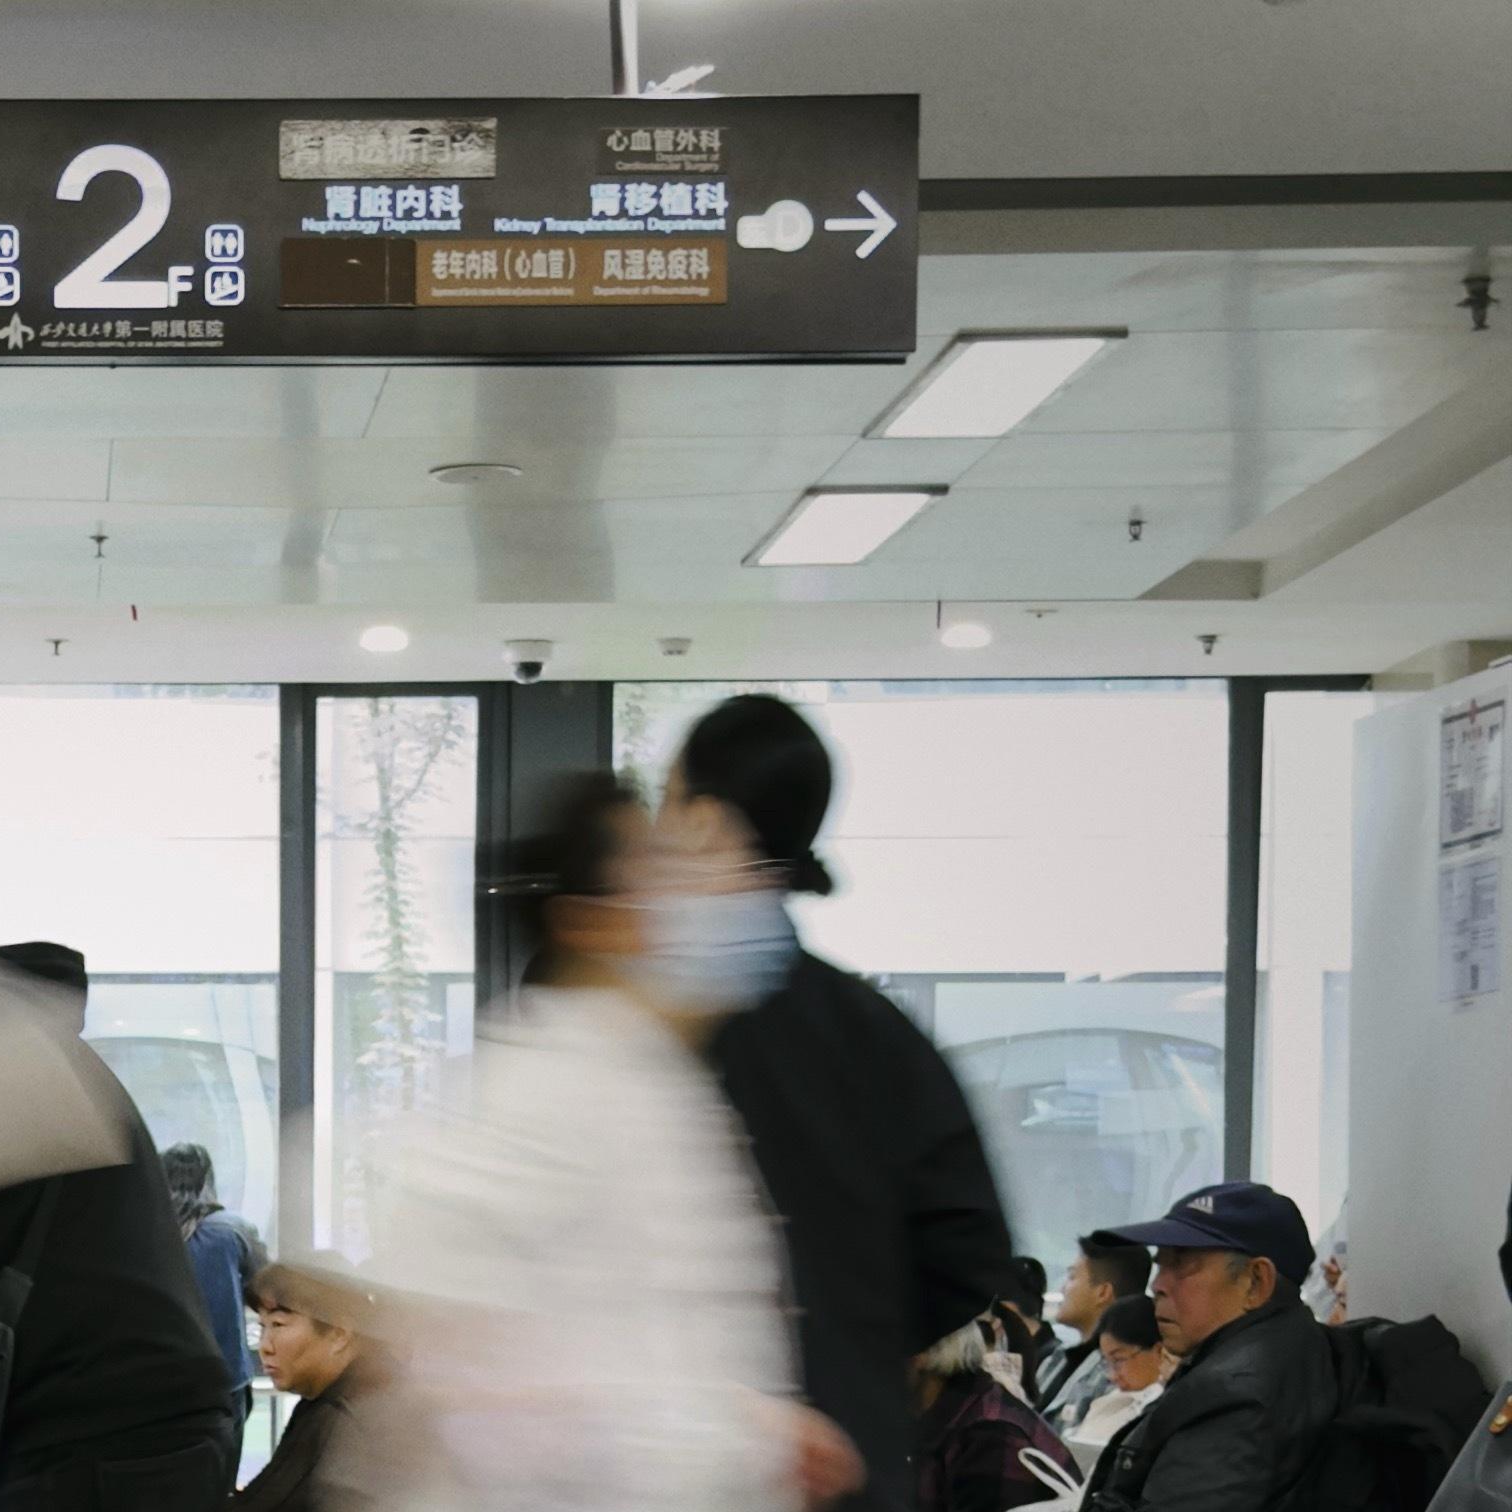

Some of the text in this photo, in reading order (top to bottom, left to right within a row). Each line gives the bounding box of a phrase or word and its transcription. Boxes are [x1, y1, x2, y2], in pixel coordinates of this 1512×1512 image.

[607, 129, 721, 152] 心血管外科
[325, 184, 464, 219] 肾脏内科
[590, 182, 728, 217] 肾移植科
[603, 248, 710, 280] 风湿免疫科
